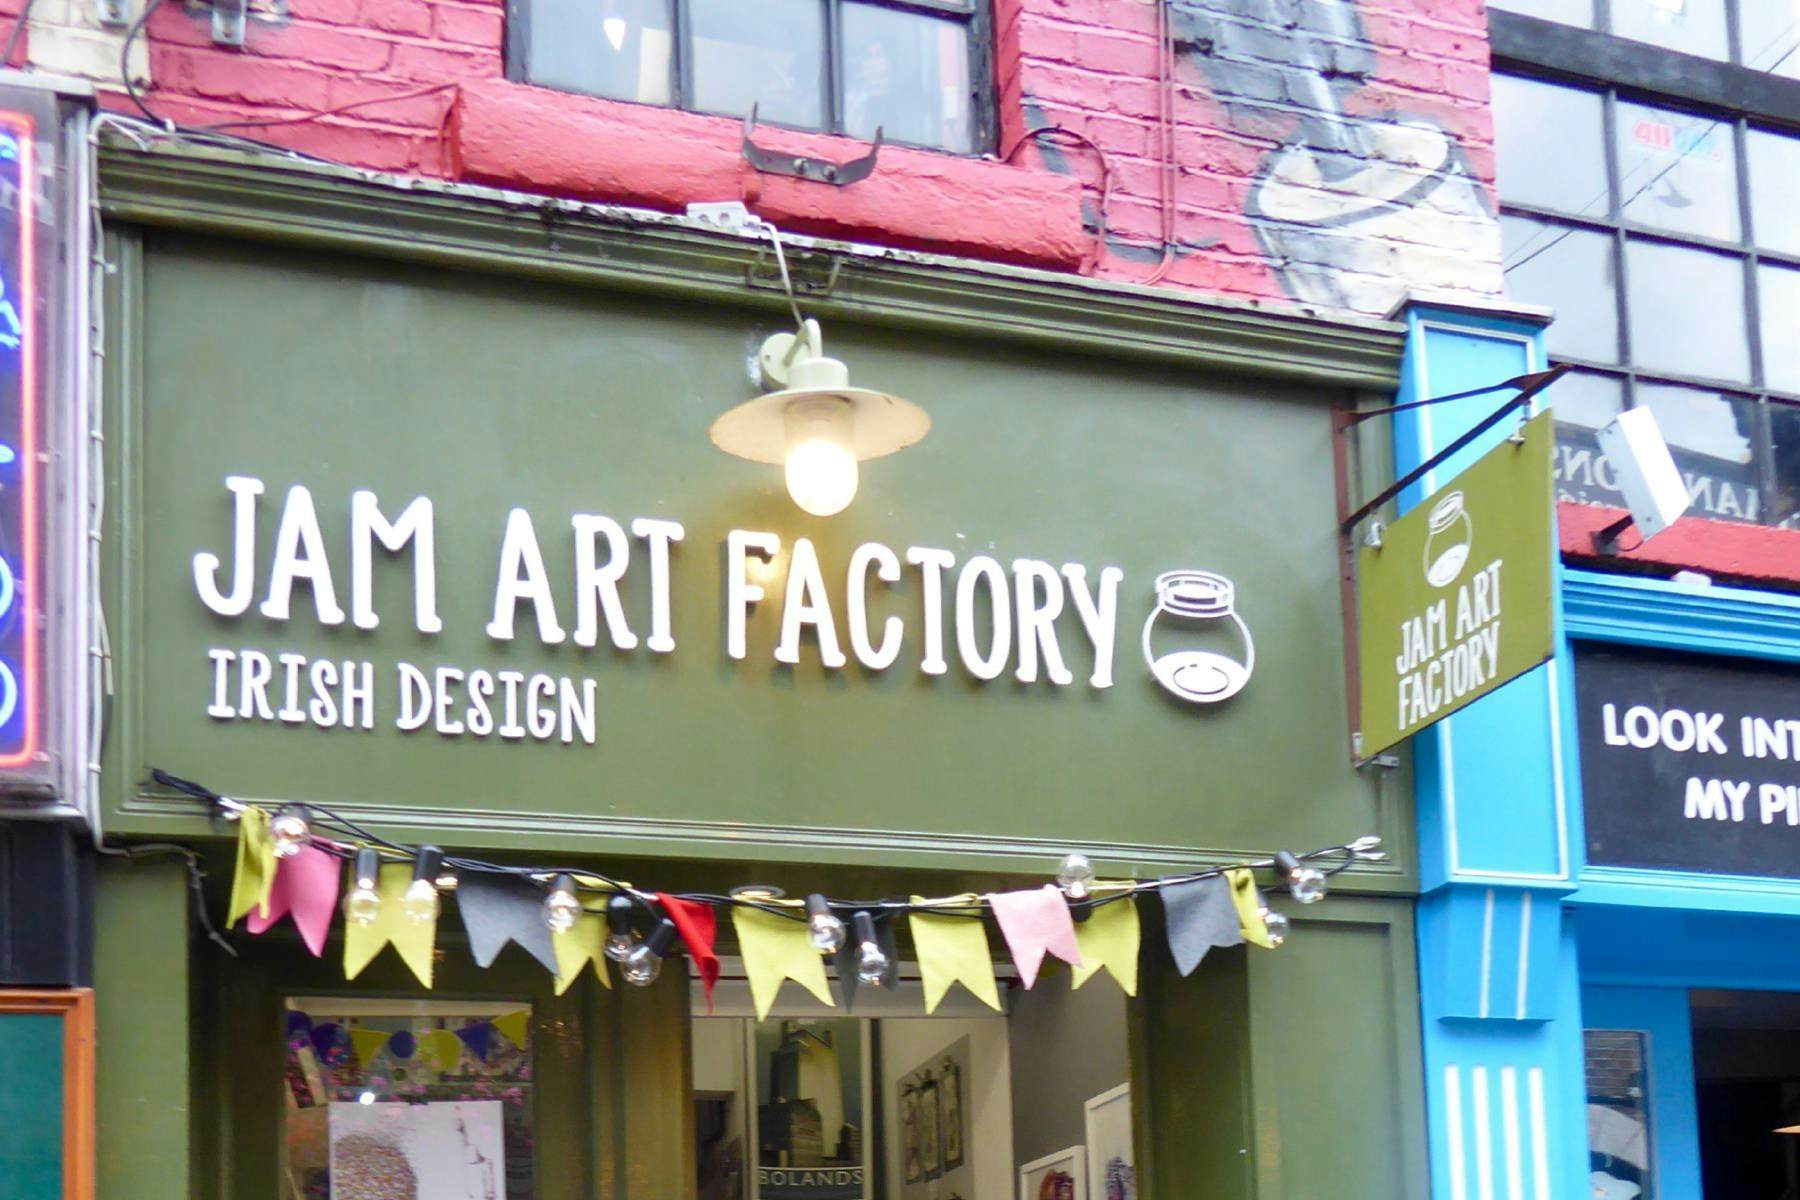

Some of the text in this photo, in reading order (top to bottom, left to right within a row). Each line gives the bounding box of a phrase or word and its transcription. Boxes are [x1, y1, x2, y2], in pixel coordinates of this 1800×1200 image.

[193, 476, 443, 634] JAM
[486, 508, 685, 653] ART
[727, 529, 1124, 689] FACTORY
[1396, 559, 1503, 675] JAM ART
[207, 649, 598, 745] IRISH DESIGN
[1398, 621, 1501, 731] FACTORY
[1603, 703, 1728, 755] LOOK
[1684, 777, 1800, 827] MY PI
[758, 1169, 864, 1187] BOLANDS
